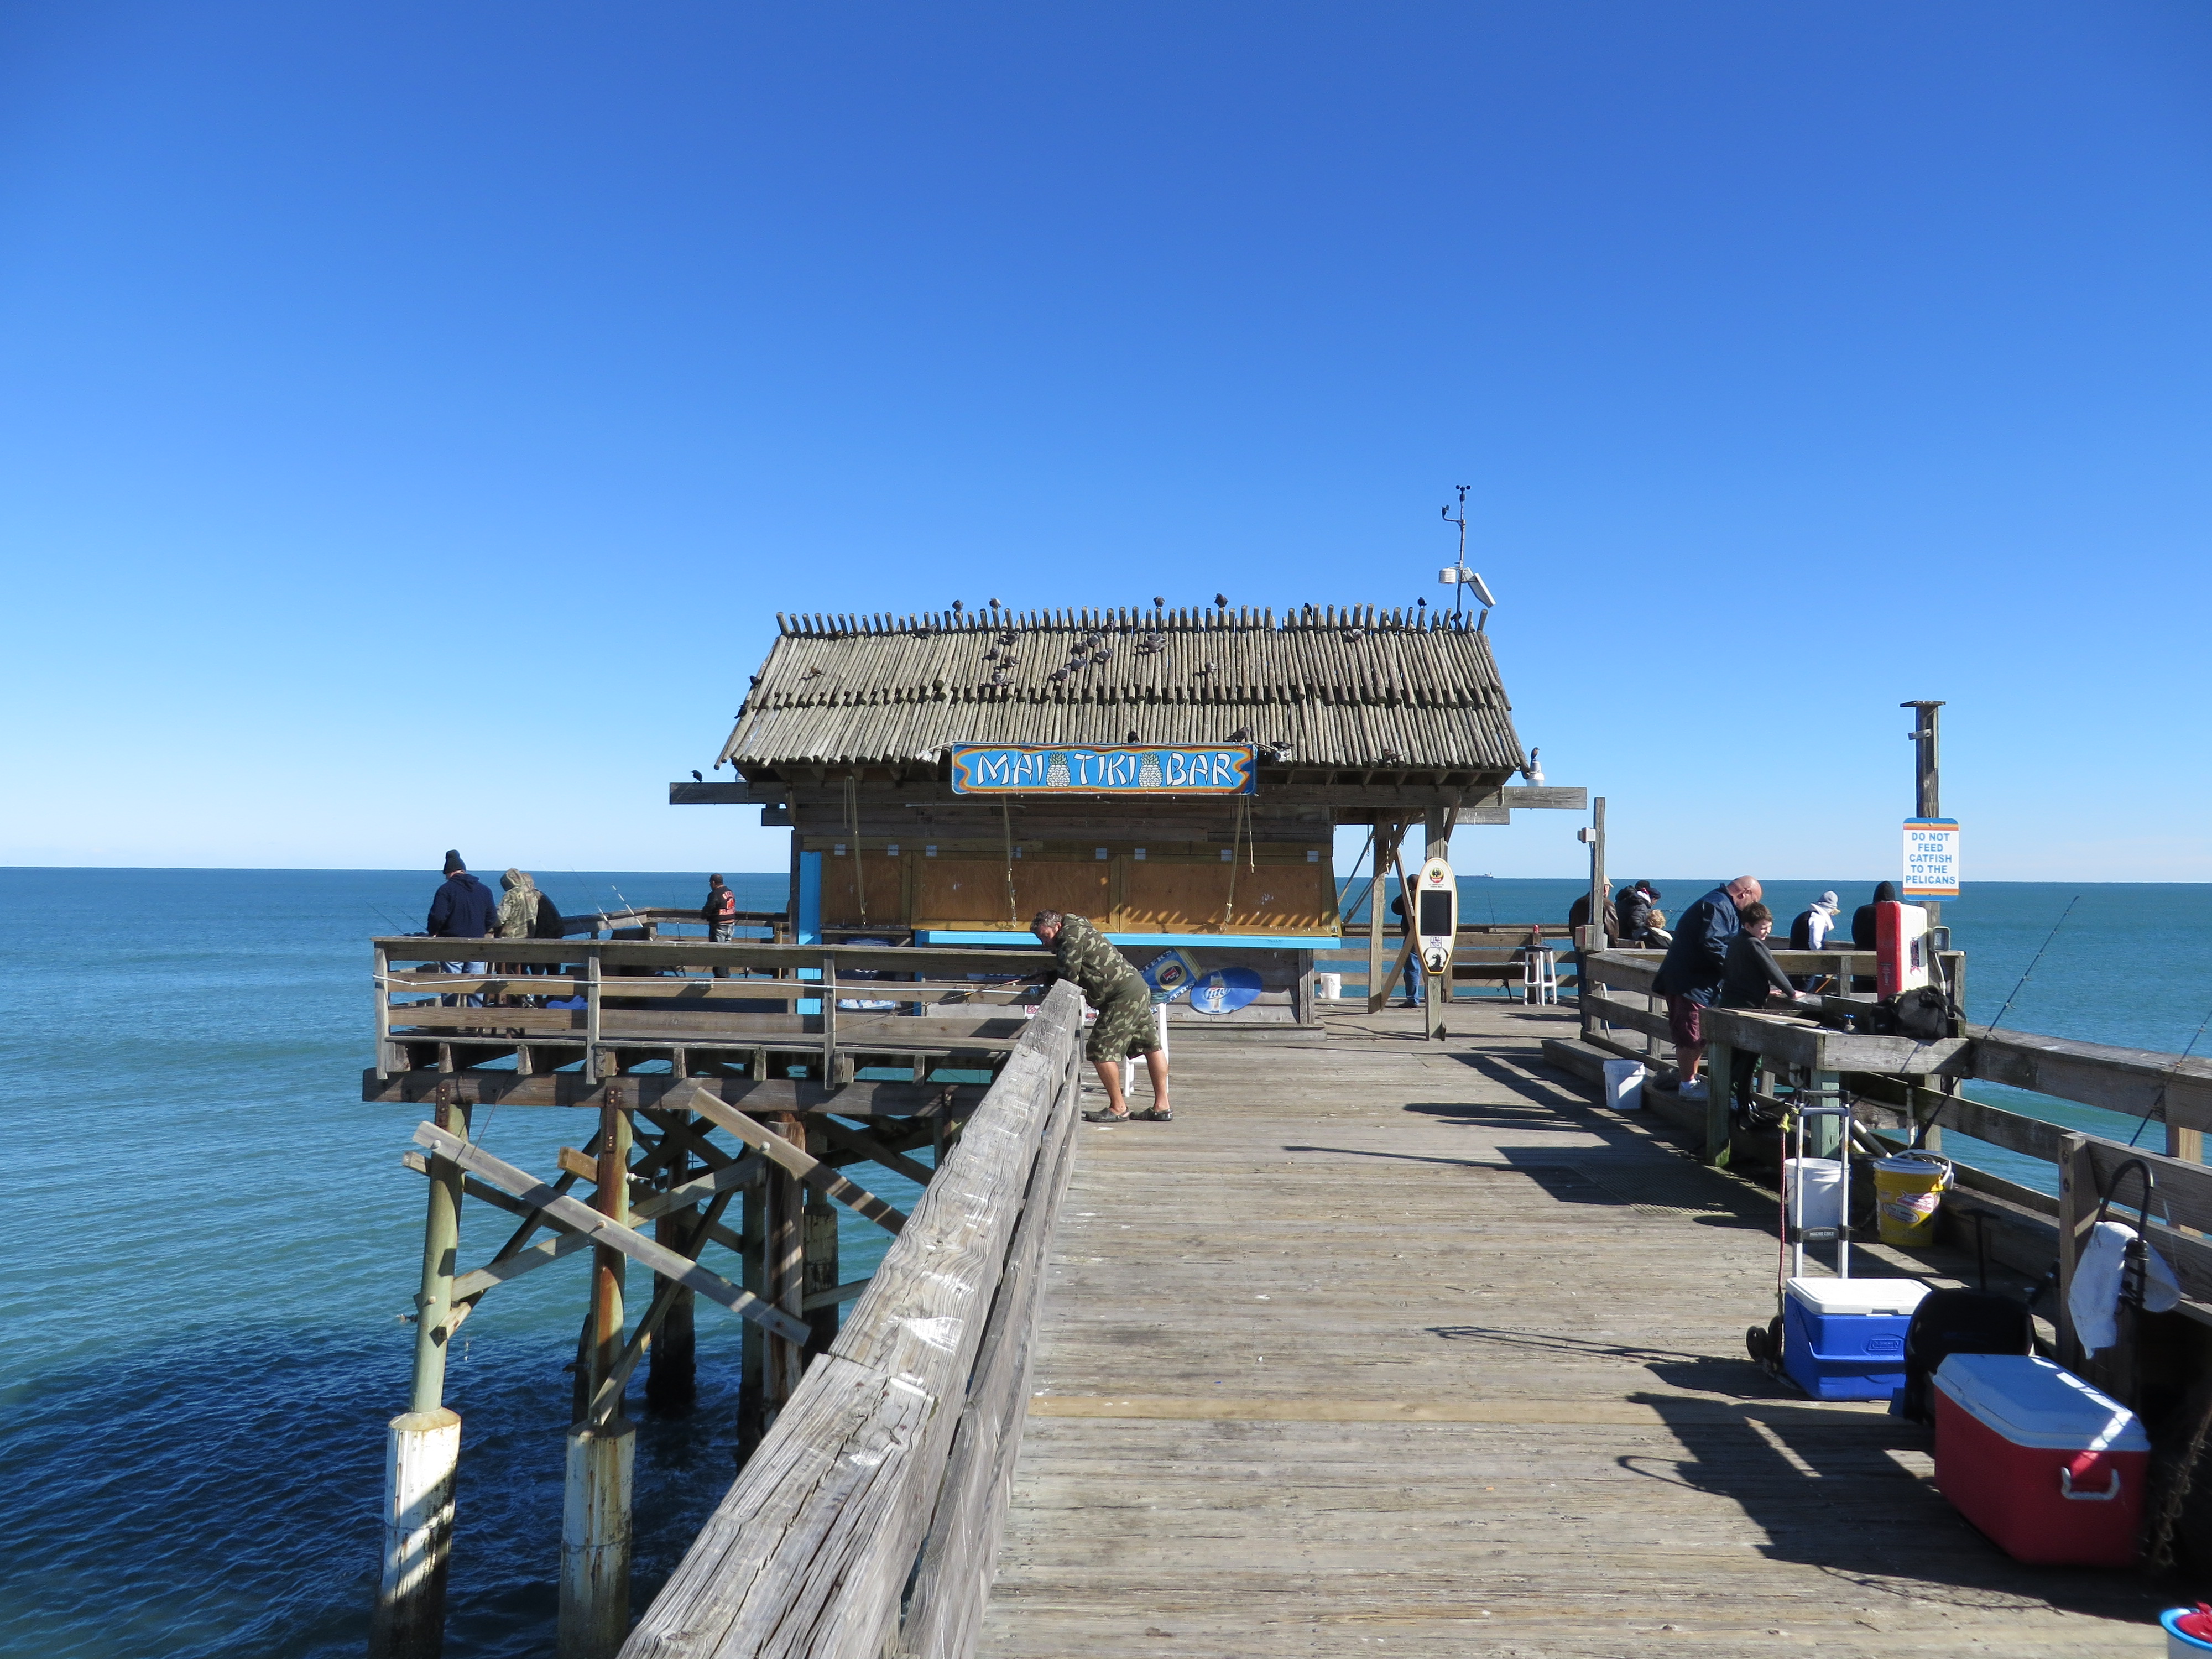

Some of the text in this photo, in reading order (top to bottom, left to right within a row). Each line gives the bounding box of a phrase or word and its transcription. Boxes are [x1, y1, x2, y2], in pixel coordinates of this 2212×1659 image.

[977, 753, 1234, 786] MAI TIKI BAR
[1912, 832, 1950, 841] DO NOT
[1918, 843, 1943, 852] FEED
[1909, 854, 1952, 863] CATFISH
[1911, 865, 1948, 873] TO THE
[1906, 875, 1955, 884] PELICANS
[1138, 949, 1172, 974] STER'S
